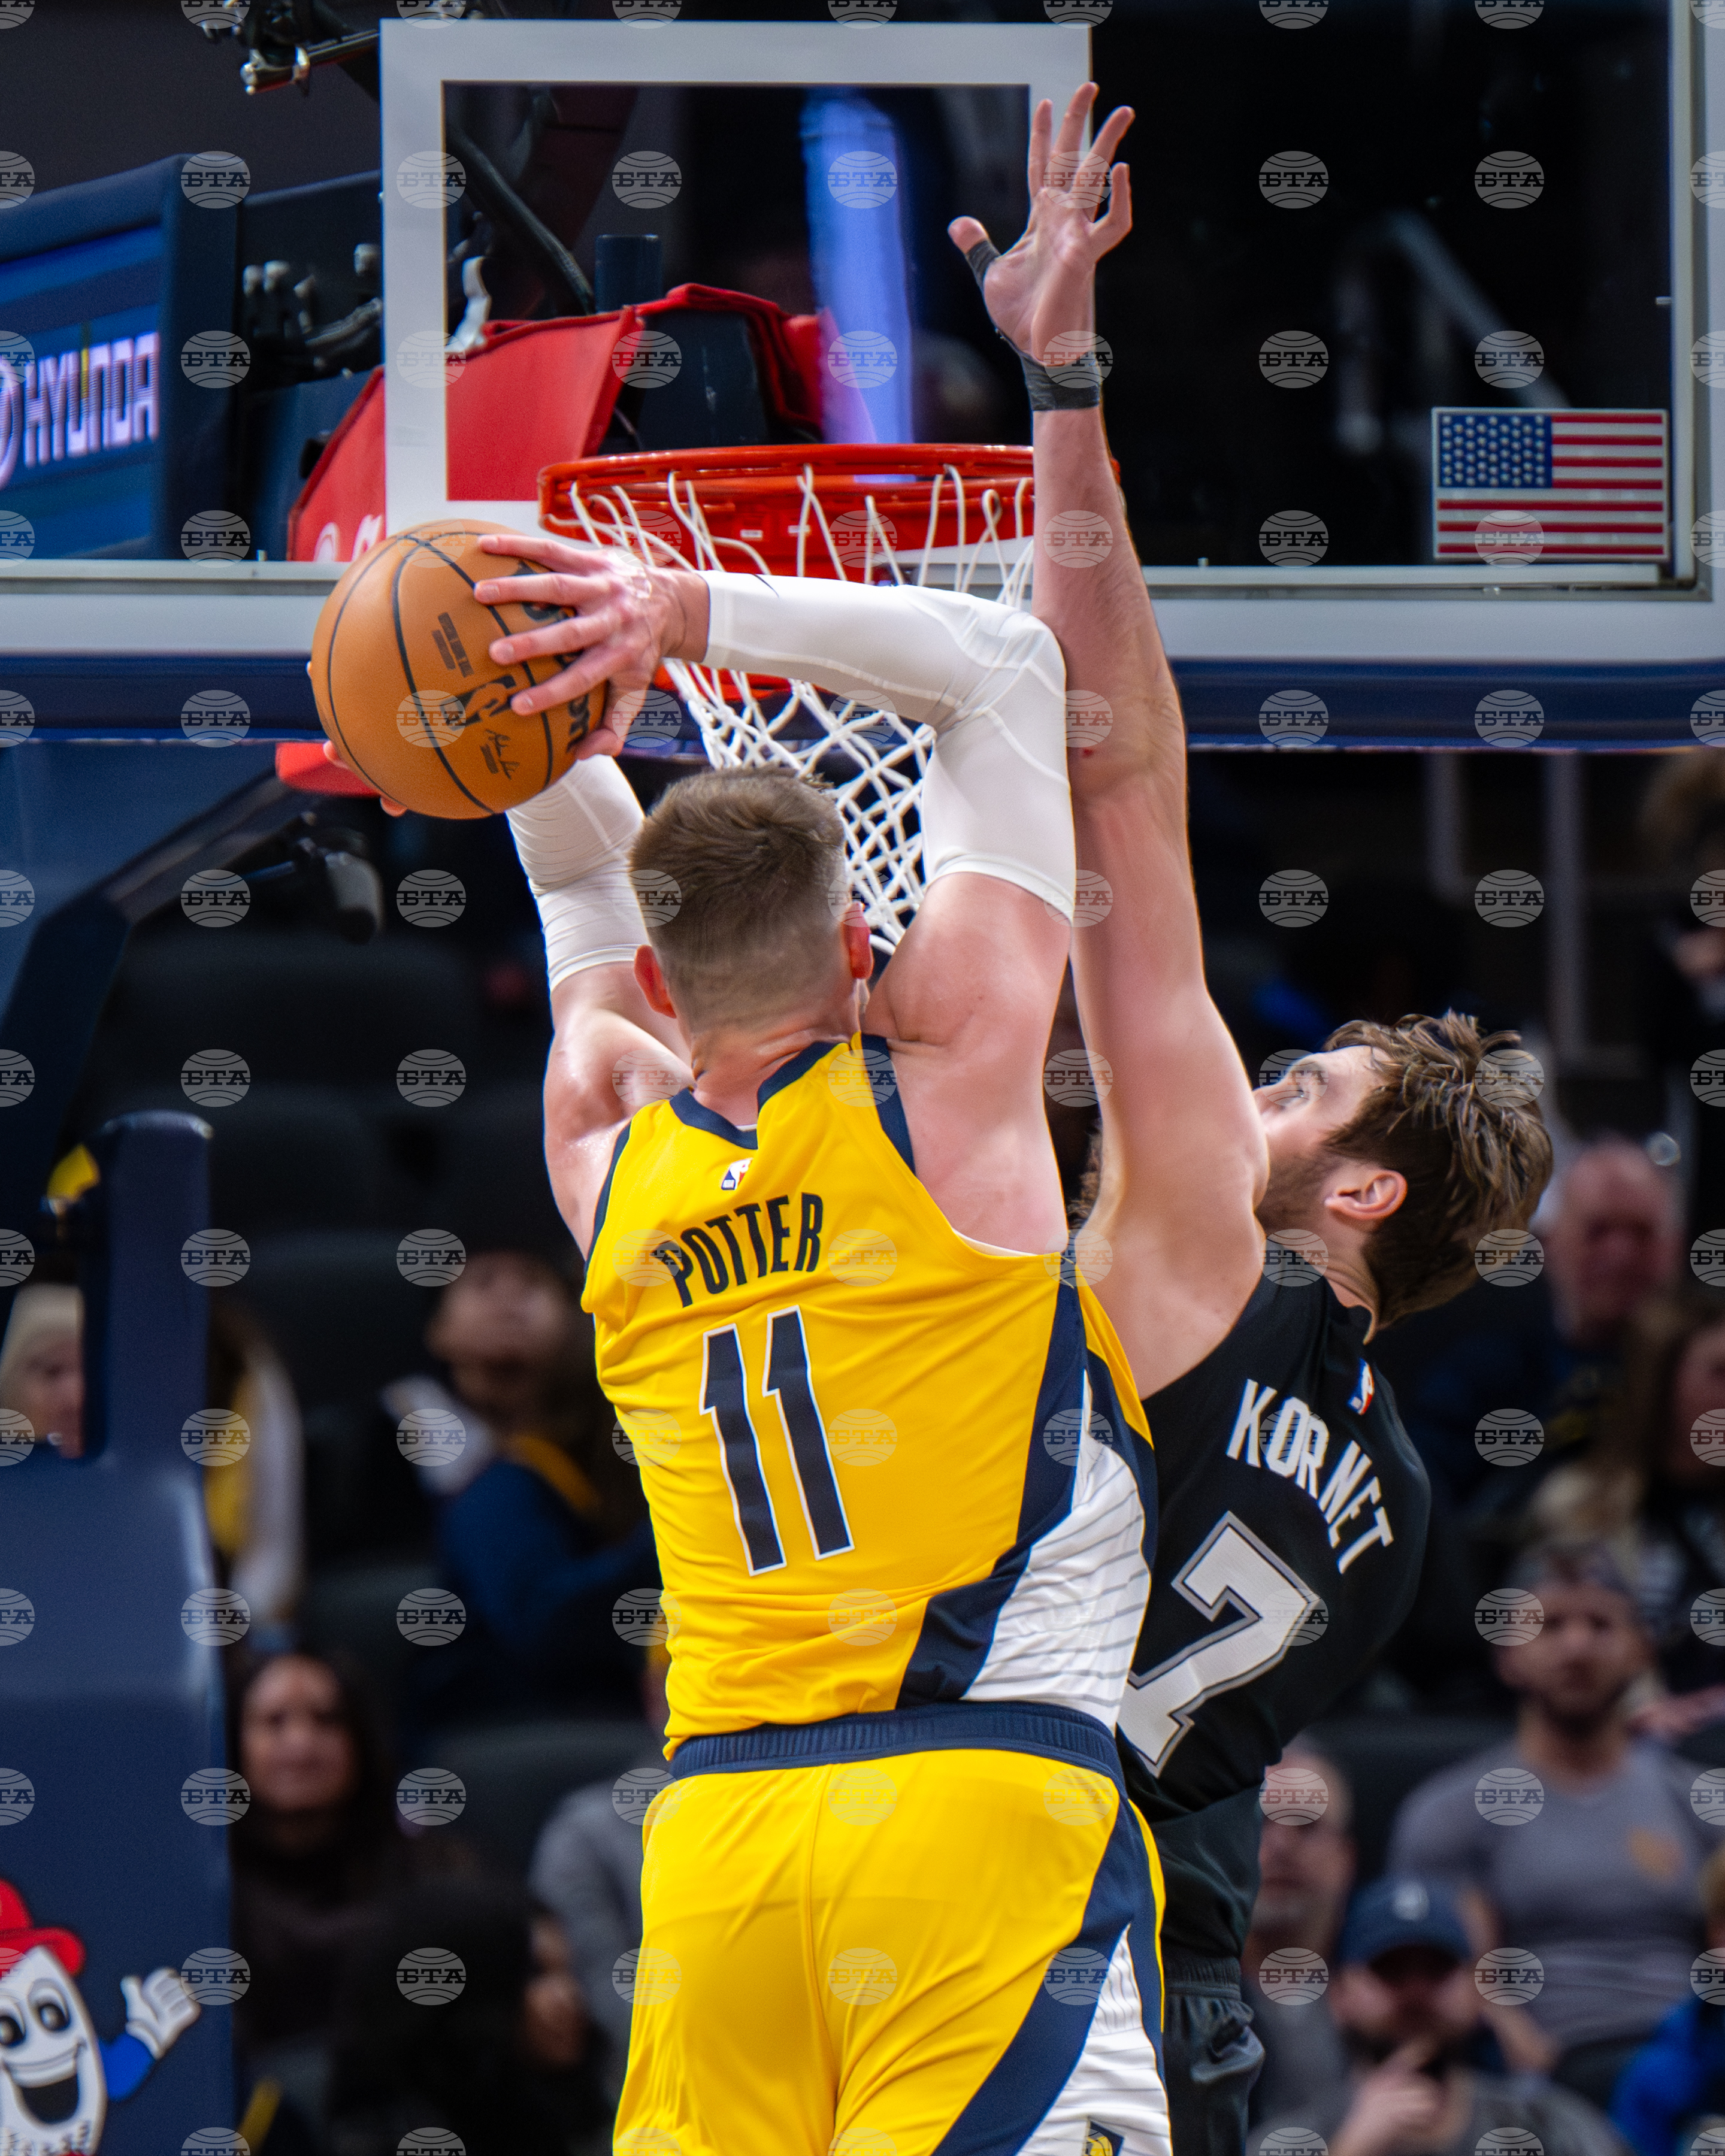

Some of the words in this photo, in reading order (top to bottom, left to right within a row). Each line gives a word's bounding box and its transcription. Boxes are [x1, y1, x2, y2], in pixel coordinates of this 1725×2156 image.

[650, 1192, 824, 1308] POTTER
[699, 1305, 855, 1576] 11
[1225, 1378, 1394, 1574] KORNET
[1116, 1510, 1320, 1778] 7
